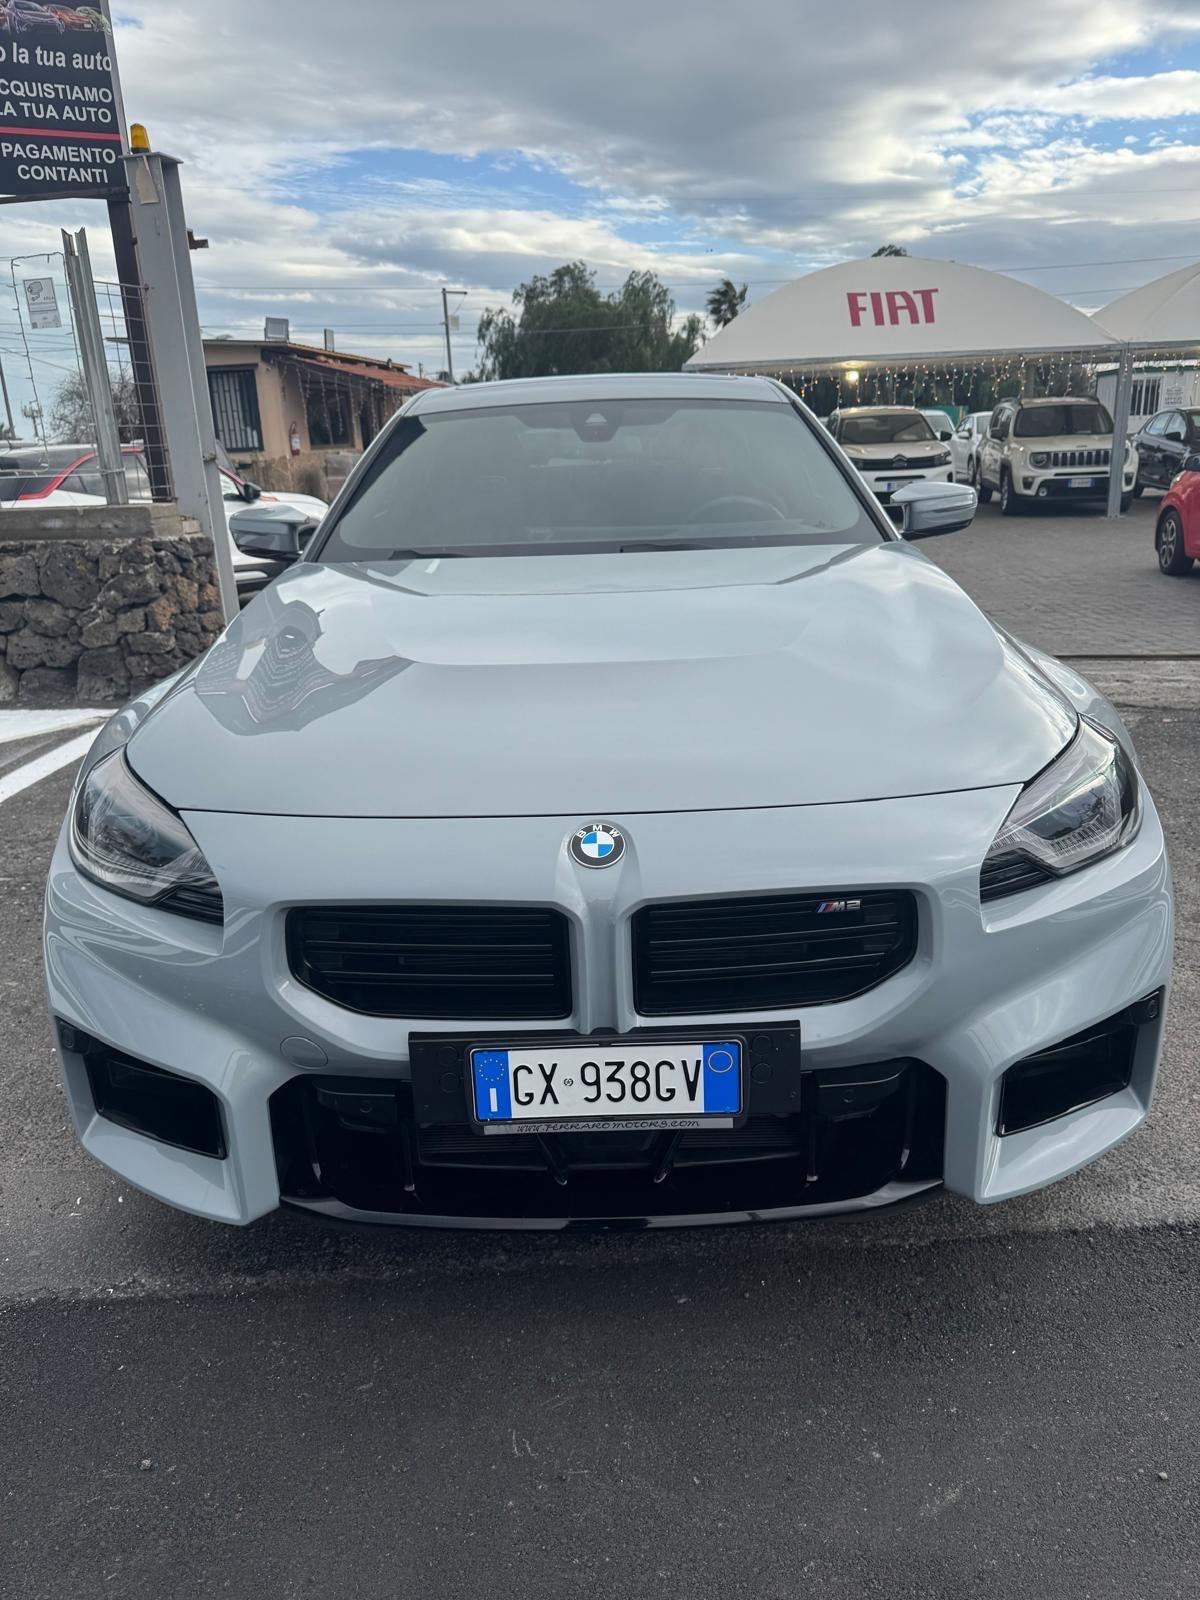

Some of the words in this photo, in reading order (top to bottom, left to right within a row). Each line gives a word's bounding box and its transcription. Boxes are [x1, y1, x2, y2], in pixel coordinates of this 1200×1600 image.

[13, 42, 29, 64] la
[35, 46, 66, 67] tua
[72, 52, 112, 71] auto
[0, 101, 17, 117] A
[19, 102, 59, 119] TUA
[63, 105, 112, 123] AUTO
[2, 142, 116, 164] PAGAMENTO
[17, 165, 109, 183] CONTANTI
[847, 288, 939, 327] FIAT
[576, 824, 620, 838] BMW
[512, 1063, 559, 1106] GX
[580, 1059, 702, 1103] 938GV
